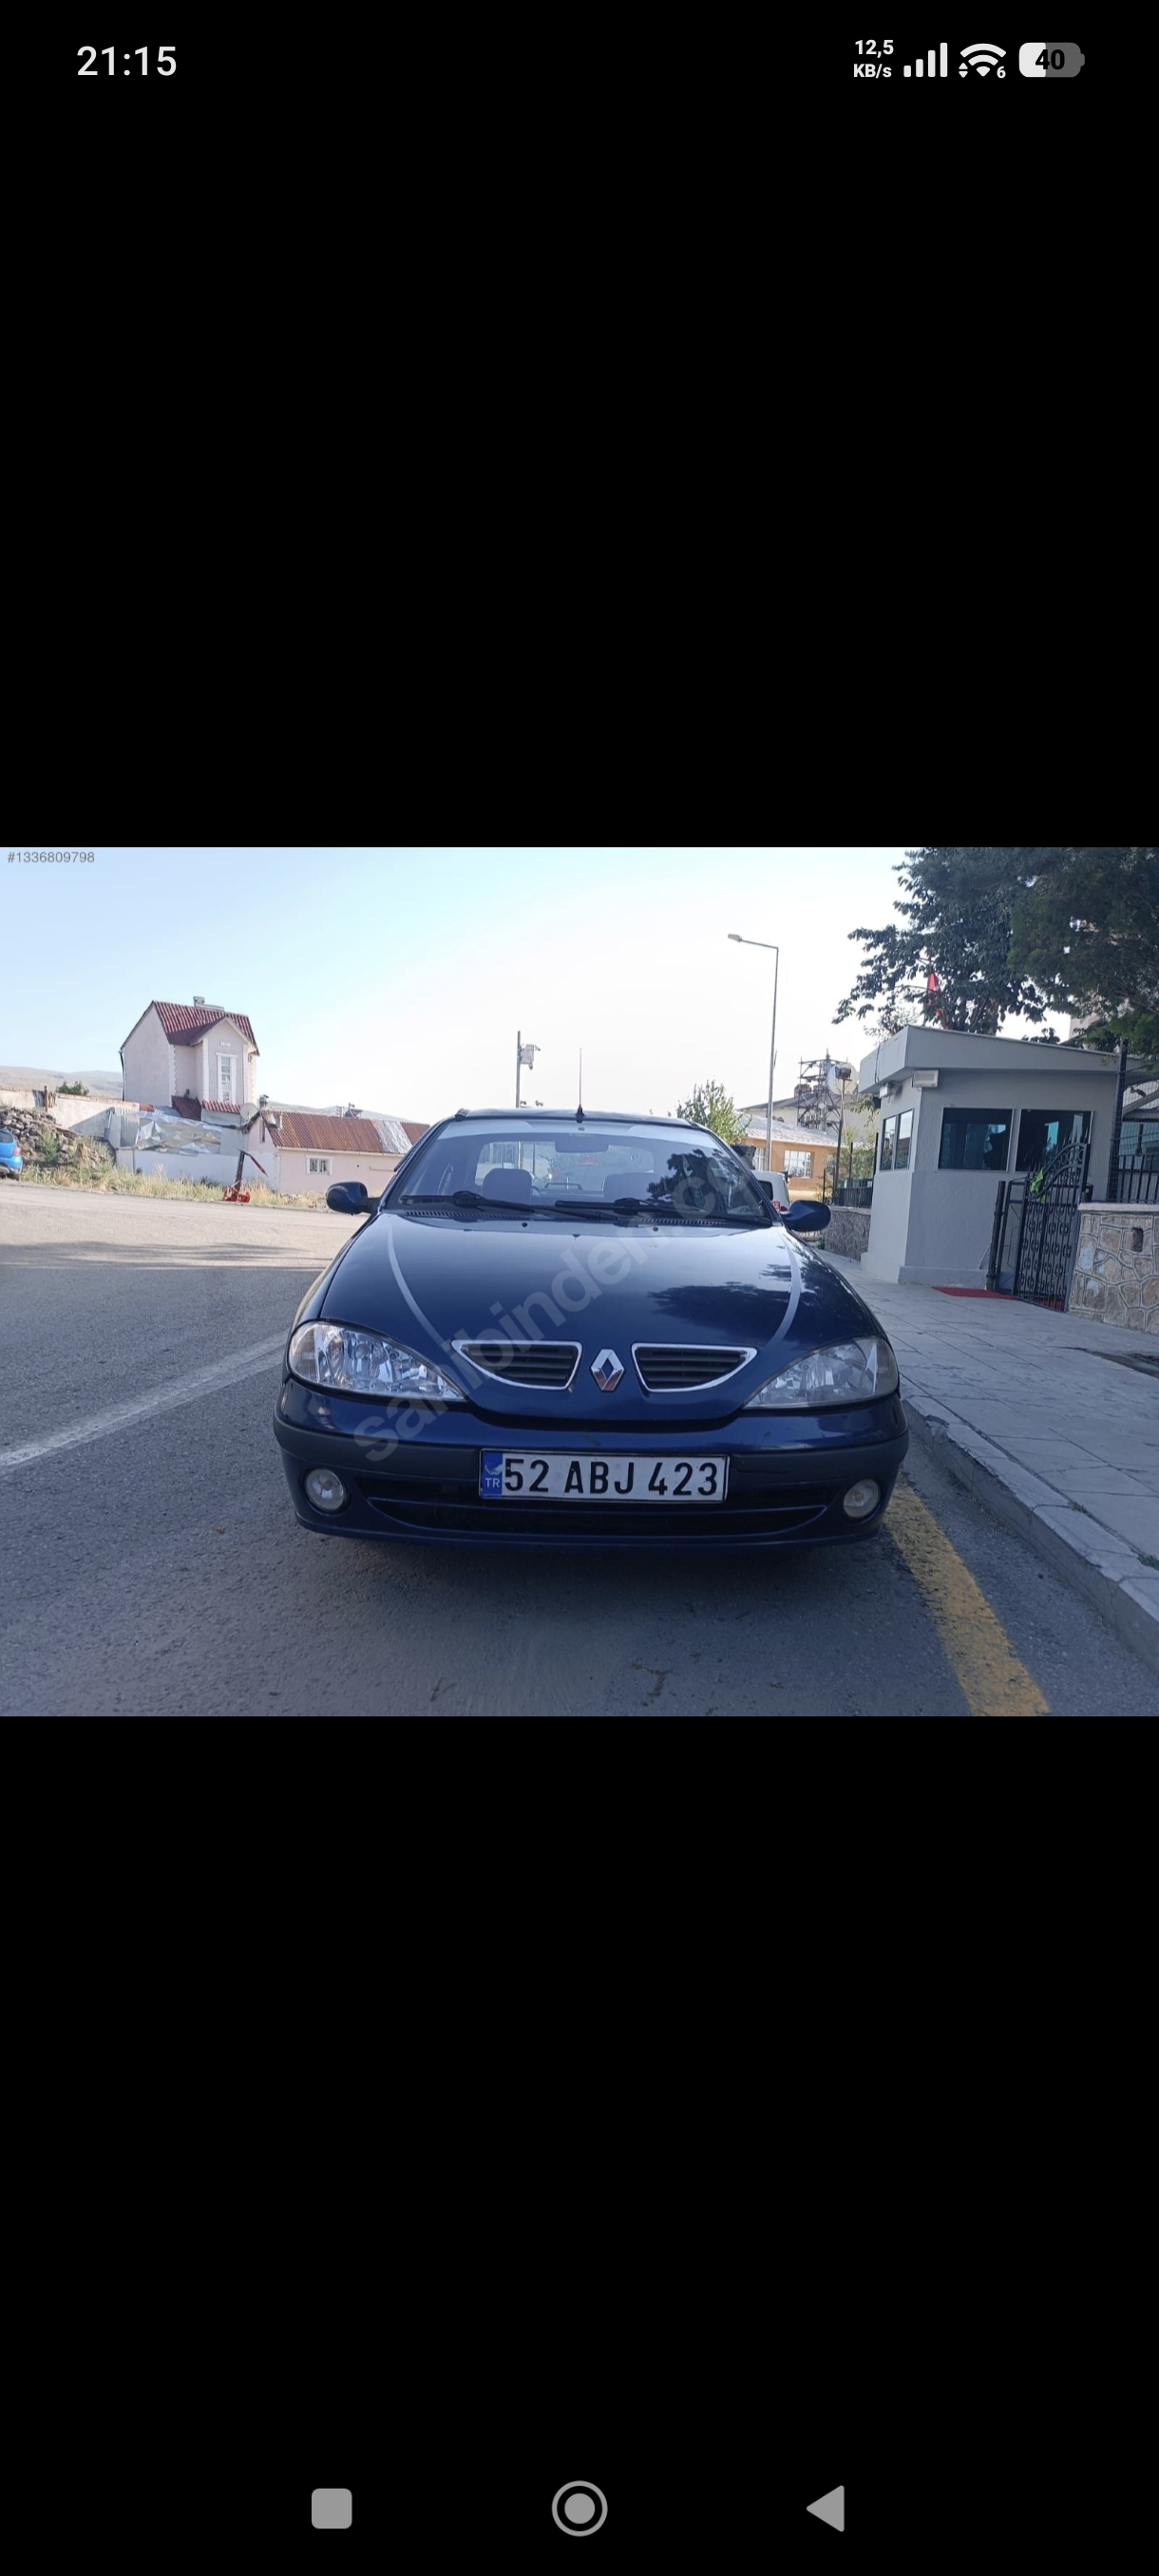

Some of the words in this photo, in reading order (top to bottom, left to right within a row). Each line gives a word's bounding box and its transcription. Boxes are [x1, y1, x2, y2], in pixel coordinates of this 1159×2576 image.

[484, 1477, 501, 1488] TR
[504, 1458, 550, 1492] 52
[564, 1461, 635, 1494] ABJ
[648, 1462, 717, 1496] 423
